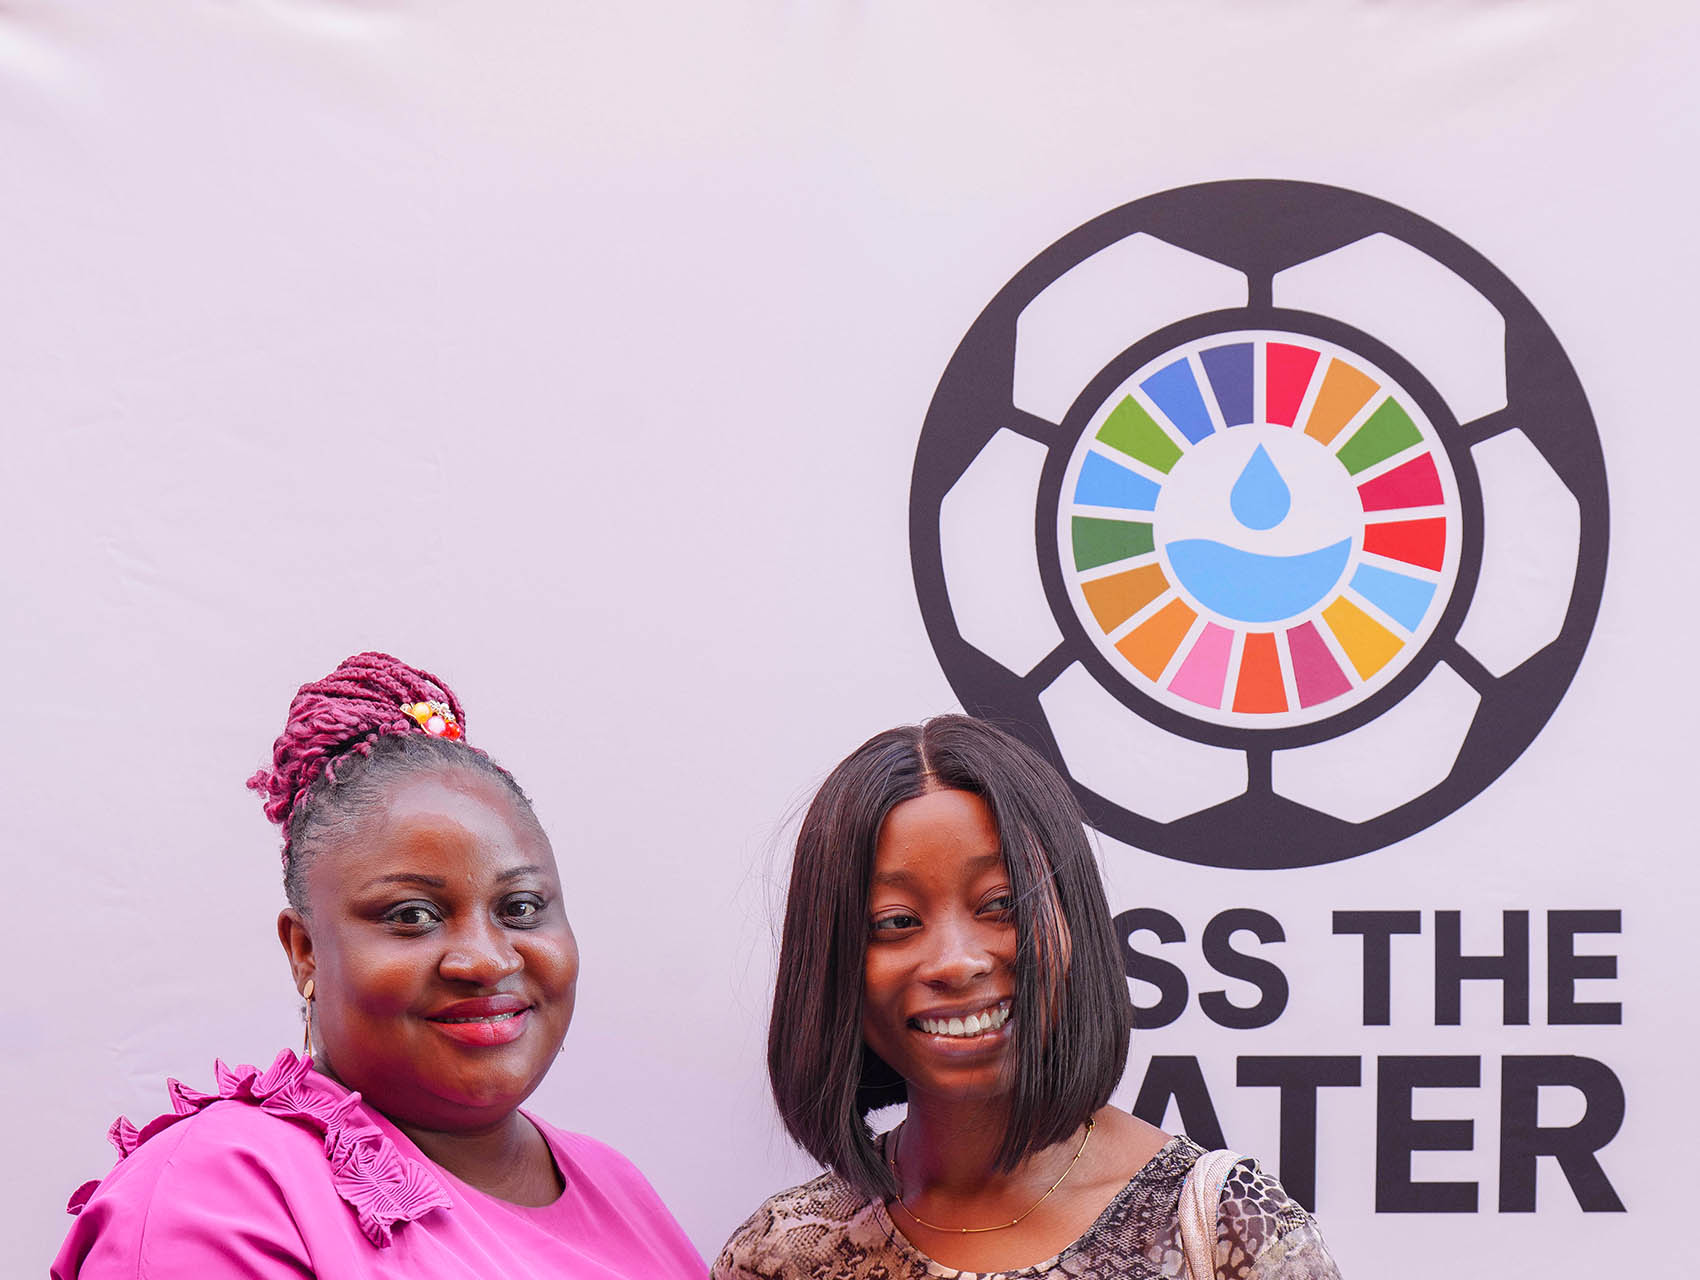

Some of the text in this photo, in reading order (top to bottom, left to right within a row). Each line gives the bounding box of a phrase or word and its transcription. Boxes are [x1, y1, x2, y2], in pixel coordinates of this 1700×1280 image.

[1112, 907, 1623, 1030] SS THE
[1132, 1055, 1628, 1214] ATER
